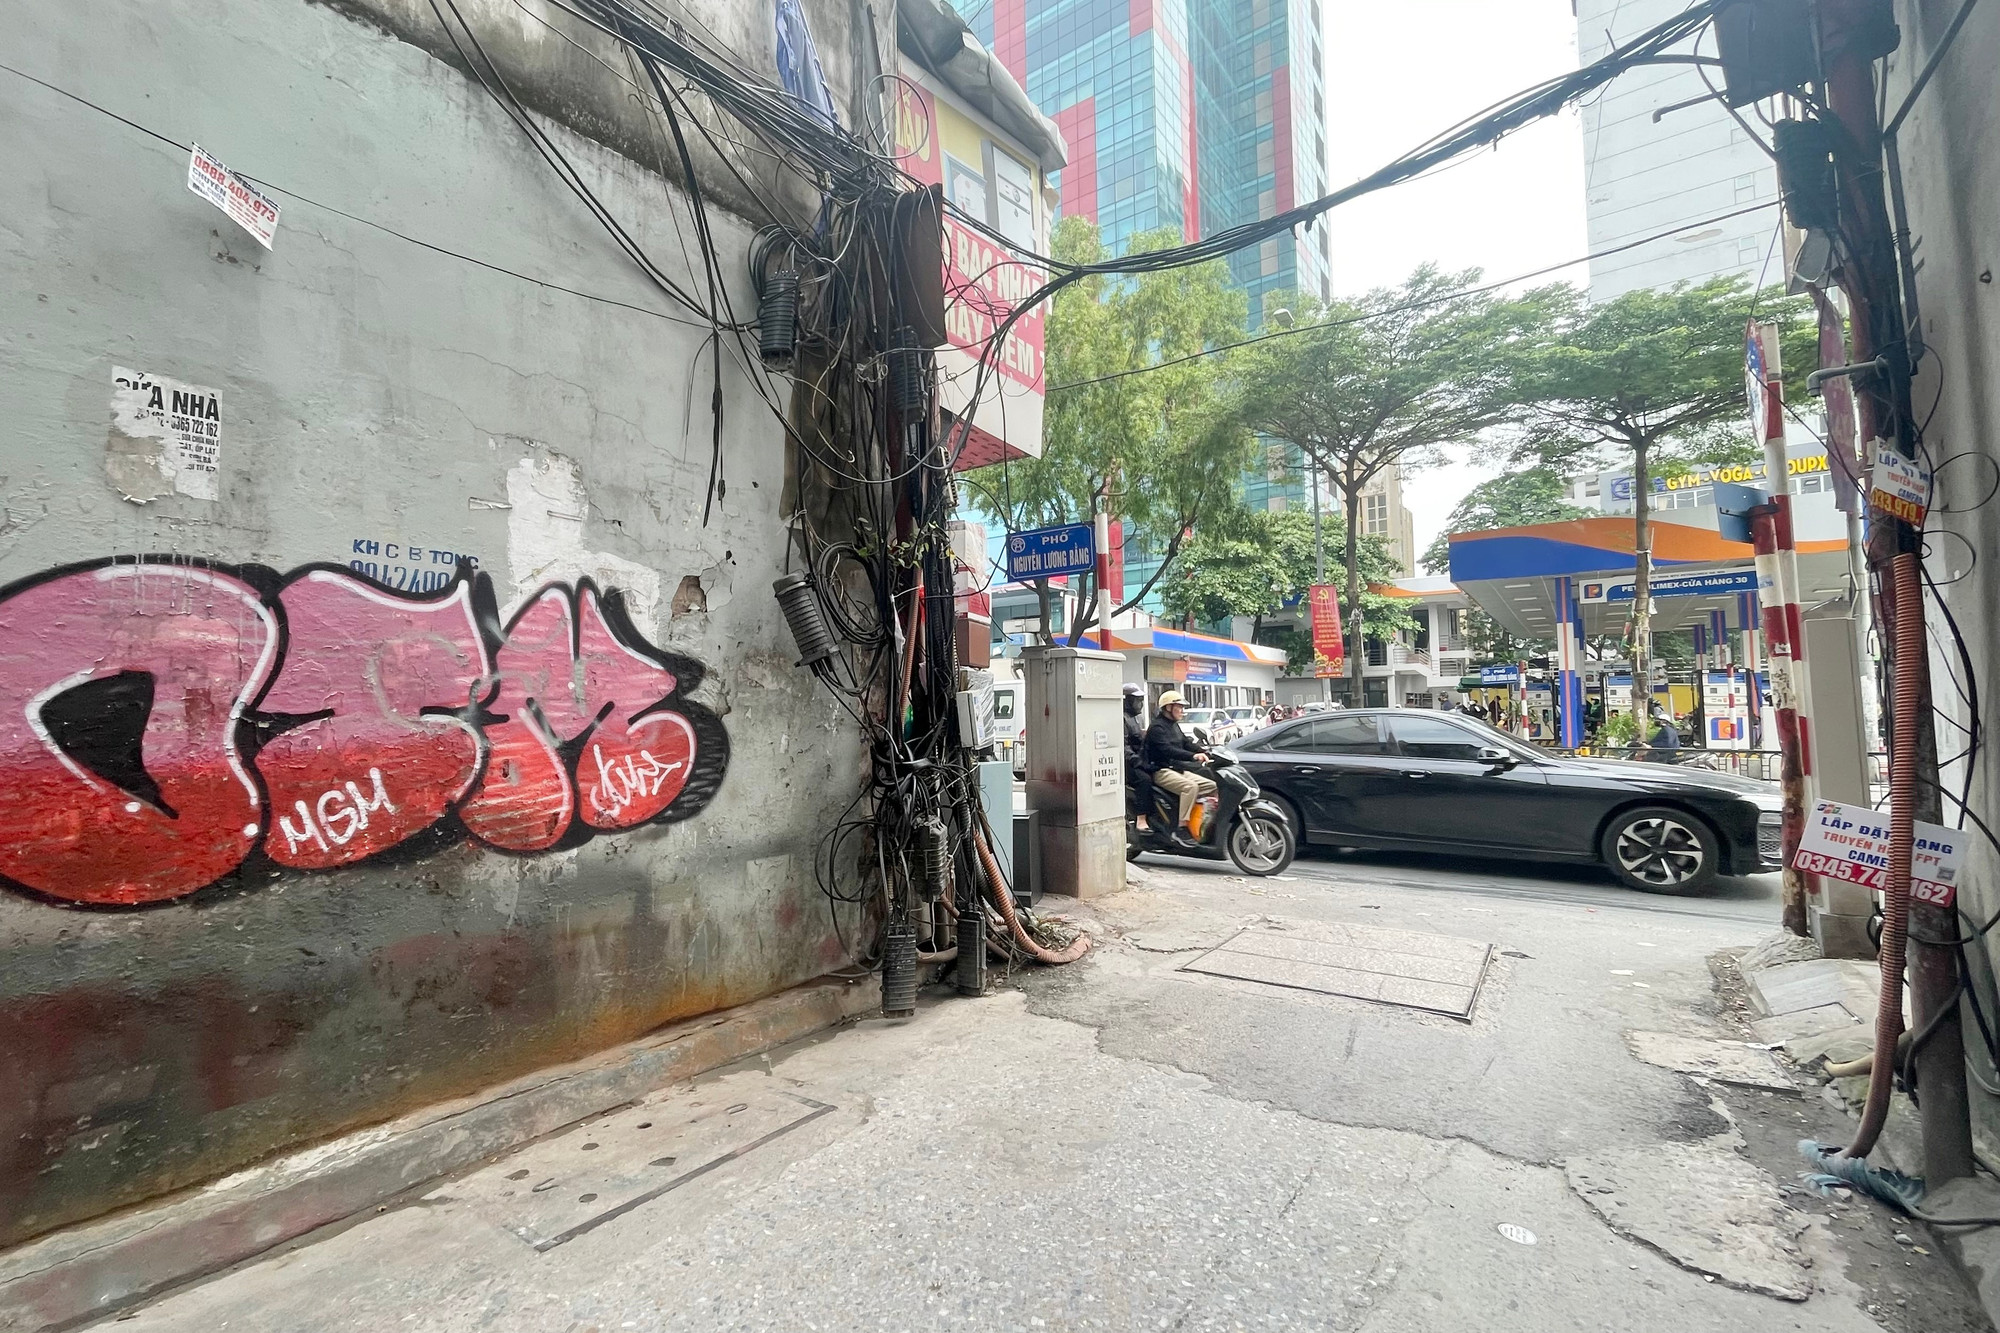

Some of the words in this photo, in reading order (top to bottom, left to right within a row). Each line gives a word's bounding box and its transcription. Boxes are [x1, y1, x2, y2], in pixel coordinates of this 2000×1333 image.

[194, 155, 277, 223] 0888.404.973
[172, 391, 220, 422] NHÀ
[192, 419, 203, 434] 722
[205, 422, 218, 437] 162
[1666, 475, 1700, 491] GYM
[1709, 466, 1753, 484] YOGA
[1042, 530, 1069, 545] PHỐ
[1013, 549, 1041, 573] NGUYỄN
[1044, 550, 1067, 569] LƯƠNG
[1069, 542, 1090, 566] BẰNG
[1705, 576, 1733, 586] HÀNG
[1735, 576, 1748, 584] 30
[280, 767, 397, 855] MGM
[1821, 816, 1853, 830] LẮP
[1858, 826, 1890, 840] ĐẶT
[1913, 838, 1953, 855] ẠNG
[1915, 853, 1942, 867] FPT
